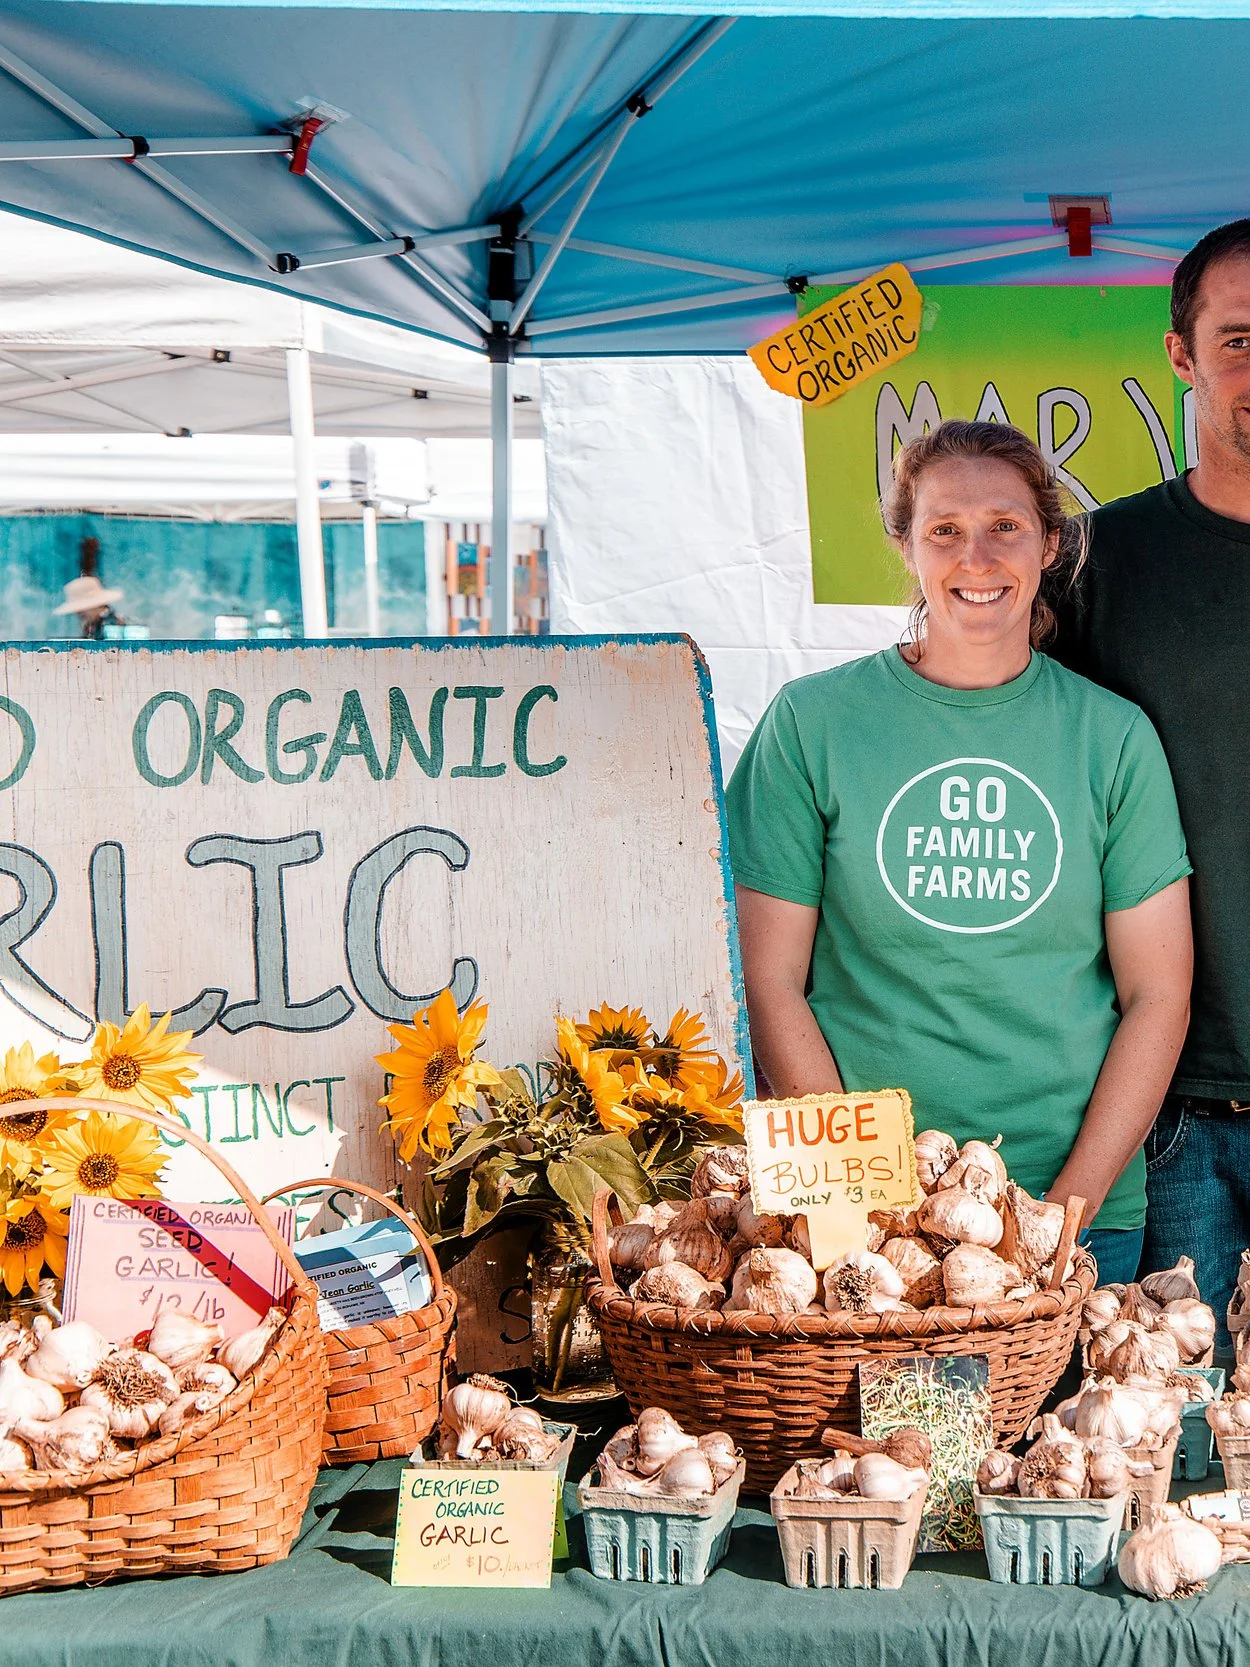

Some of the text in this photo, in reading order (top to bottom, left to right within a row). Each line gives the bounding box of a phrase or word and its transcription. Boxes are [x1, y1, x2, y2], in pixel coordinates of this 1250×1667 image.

[767, 279, 902, 374] CERTIFIED
[798, 315, 916, 402] ORGANIC
[132, 685, 568, 788] ORGANIC
[940, 775, 1007, 822] GO
[907, 826, 1036, 861] FAMILY
[907, 865, 1031, 901] FARMS
[0, 825, 478, 1043] RLIC
[767, 1103, 878, 1148] HUGE
[762, 1145, 902, 1194] BULBS!
[94, 1202, 180, 1224] CERTIFIED
[791, 1192, 831, 1207] ONLY
[870, 1189, 887, 1200] EA
[139, 1228, 203, 1250] SEED
[115, 1252, 234, 1286] GARLIC!
[309, 1262, 377, 1282] TIFIED ORGANIC
[348, 1281, 375, 1294] Garlic
[411, 1477, 499, 1498] CERTIFIED
[436, 1502, 505, 1518] ORGANIC
[421, 1523, 509, 1547] GARLIC
